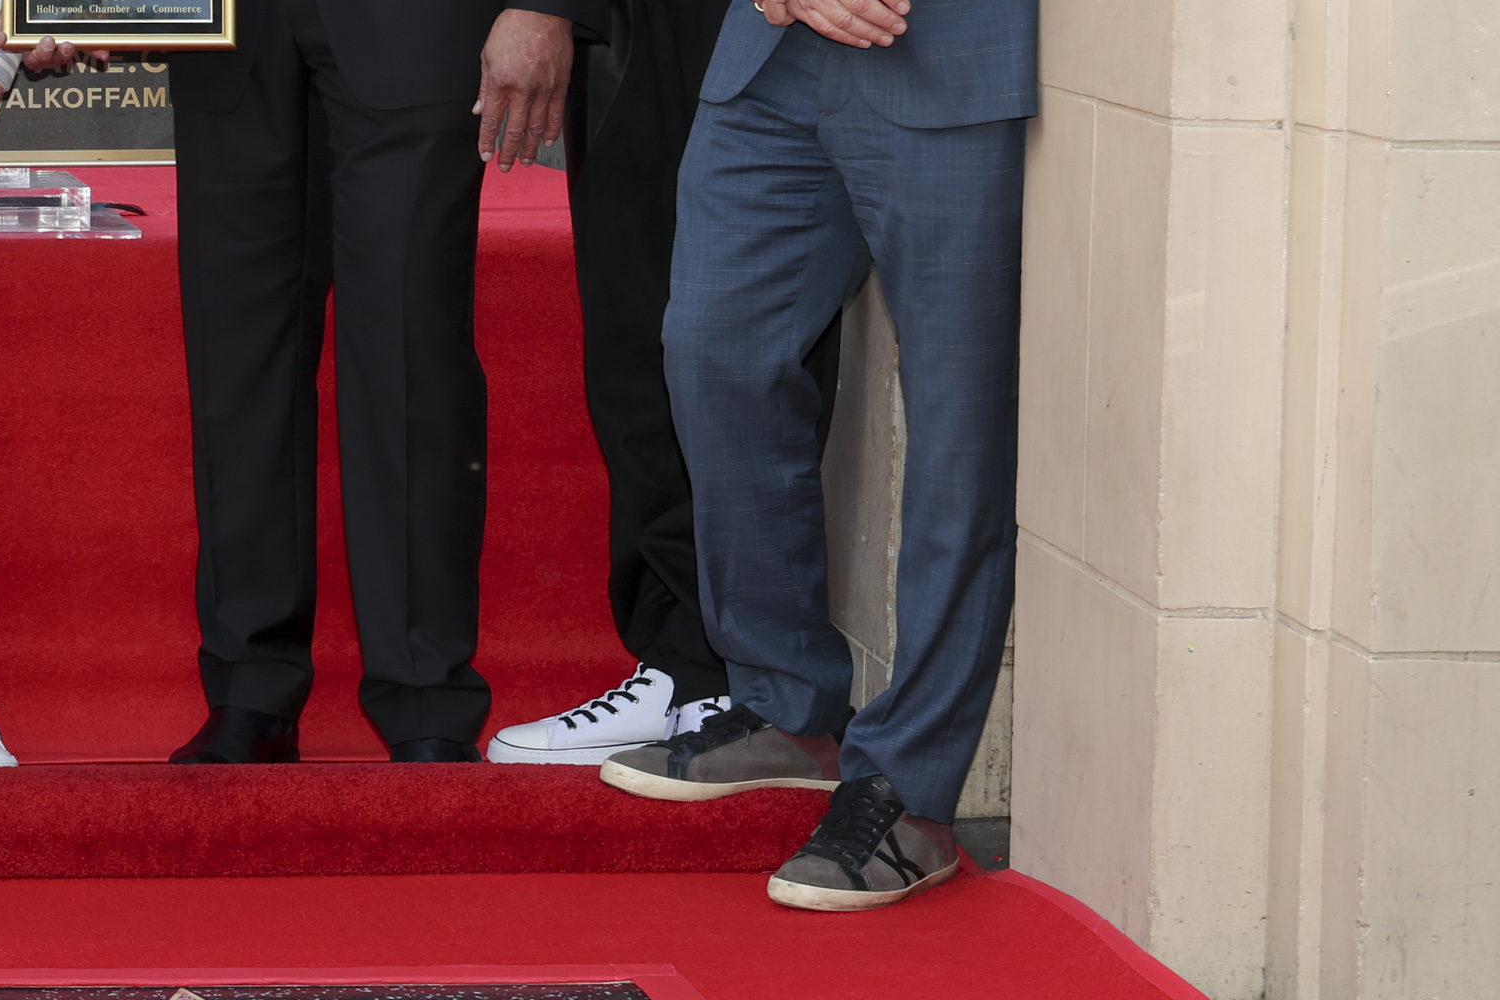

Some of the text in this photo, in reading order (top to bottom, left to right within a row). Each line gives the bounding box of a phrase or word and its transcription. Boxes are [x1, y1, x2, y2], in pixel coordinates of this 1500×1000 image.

[36, 4, 202, 15] Hollywood Chamber of Commerce
[0, 86, 174, 109] ALKOFFAM
